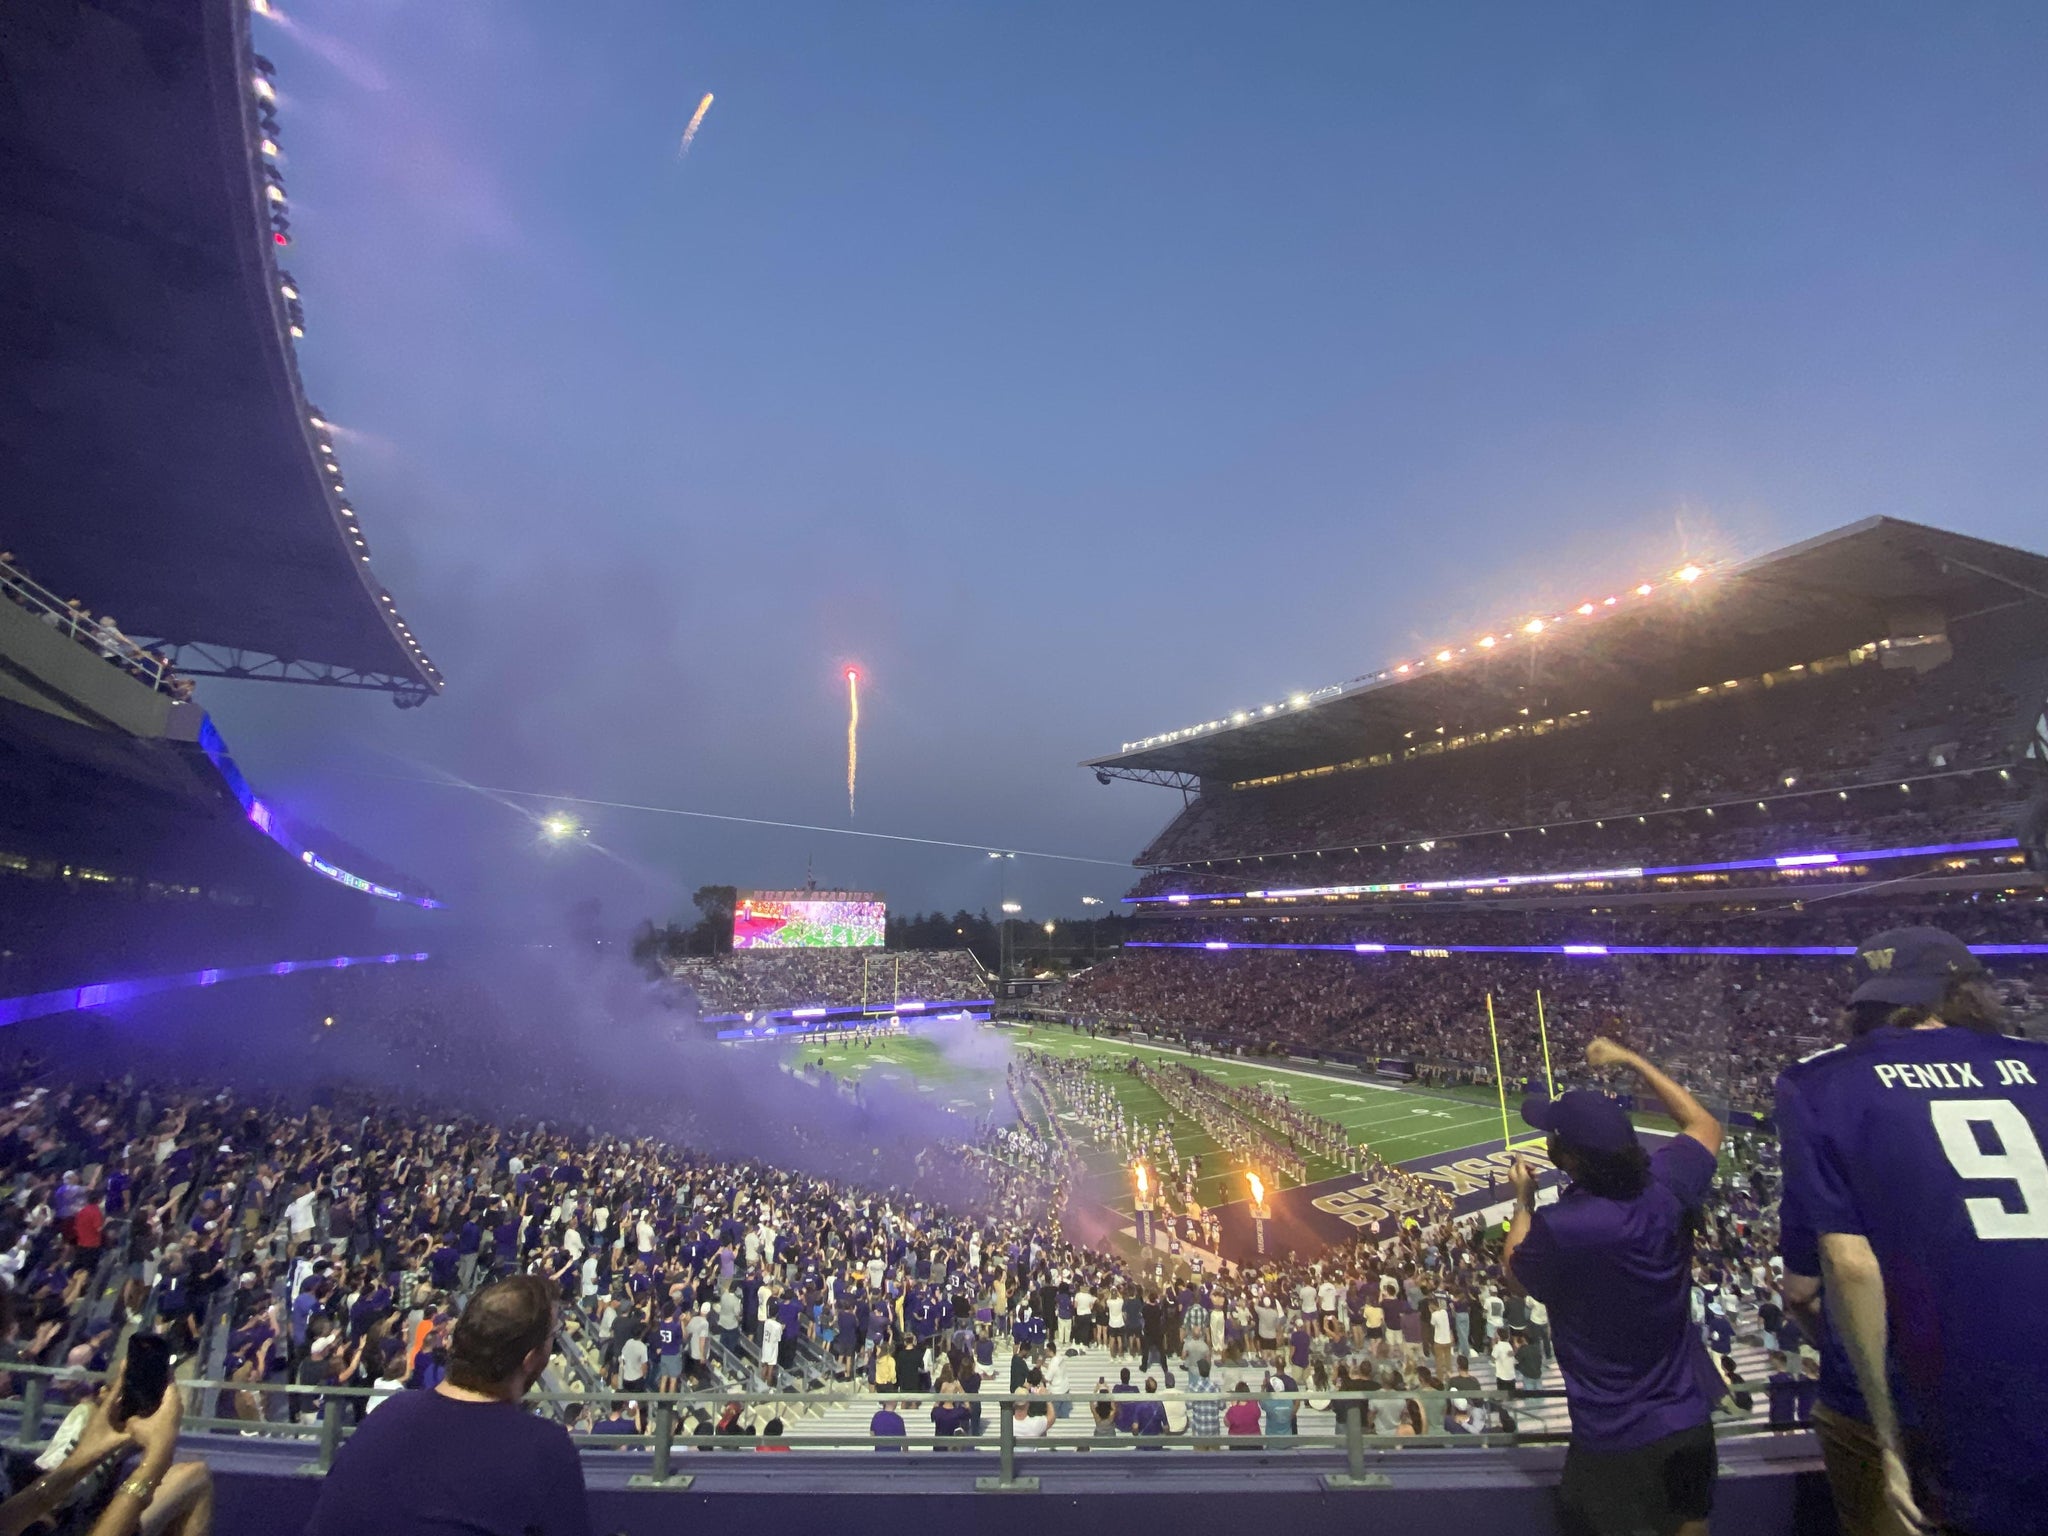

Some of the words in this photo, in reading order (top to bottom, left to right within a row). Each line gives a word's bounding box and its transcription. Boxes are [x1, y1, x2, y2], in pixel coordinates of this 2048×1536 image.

[1862, 948, 1896, 970] W
[1873, 1062, 1984, 1089] PENIX
[1999, 1059, 2038, 1087] JR
[1929, 1099, 2048, 1240] 9
[660, 1329, 673, 1344] 53
